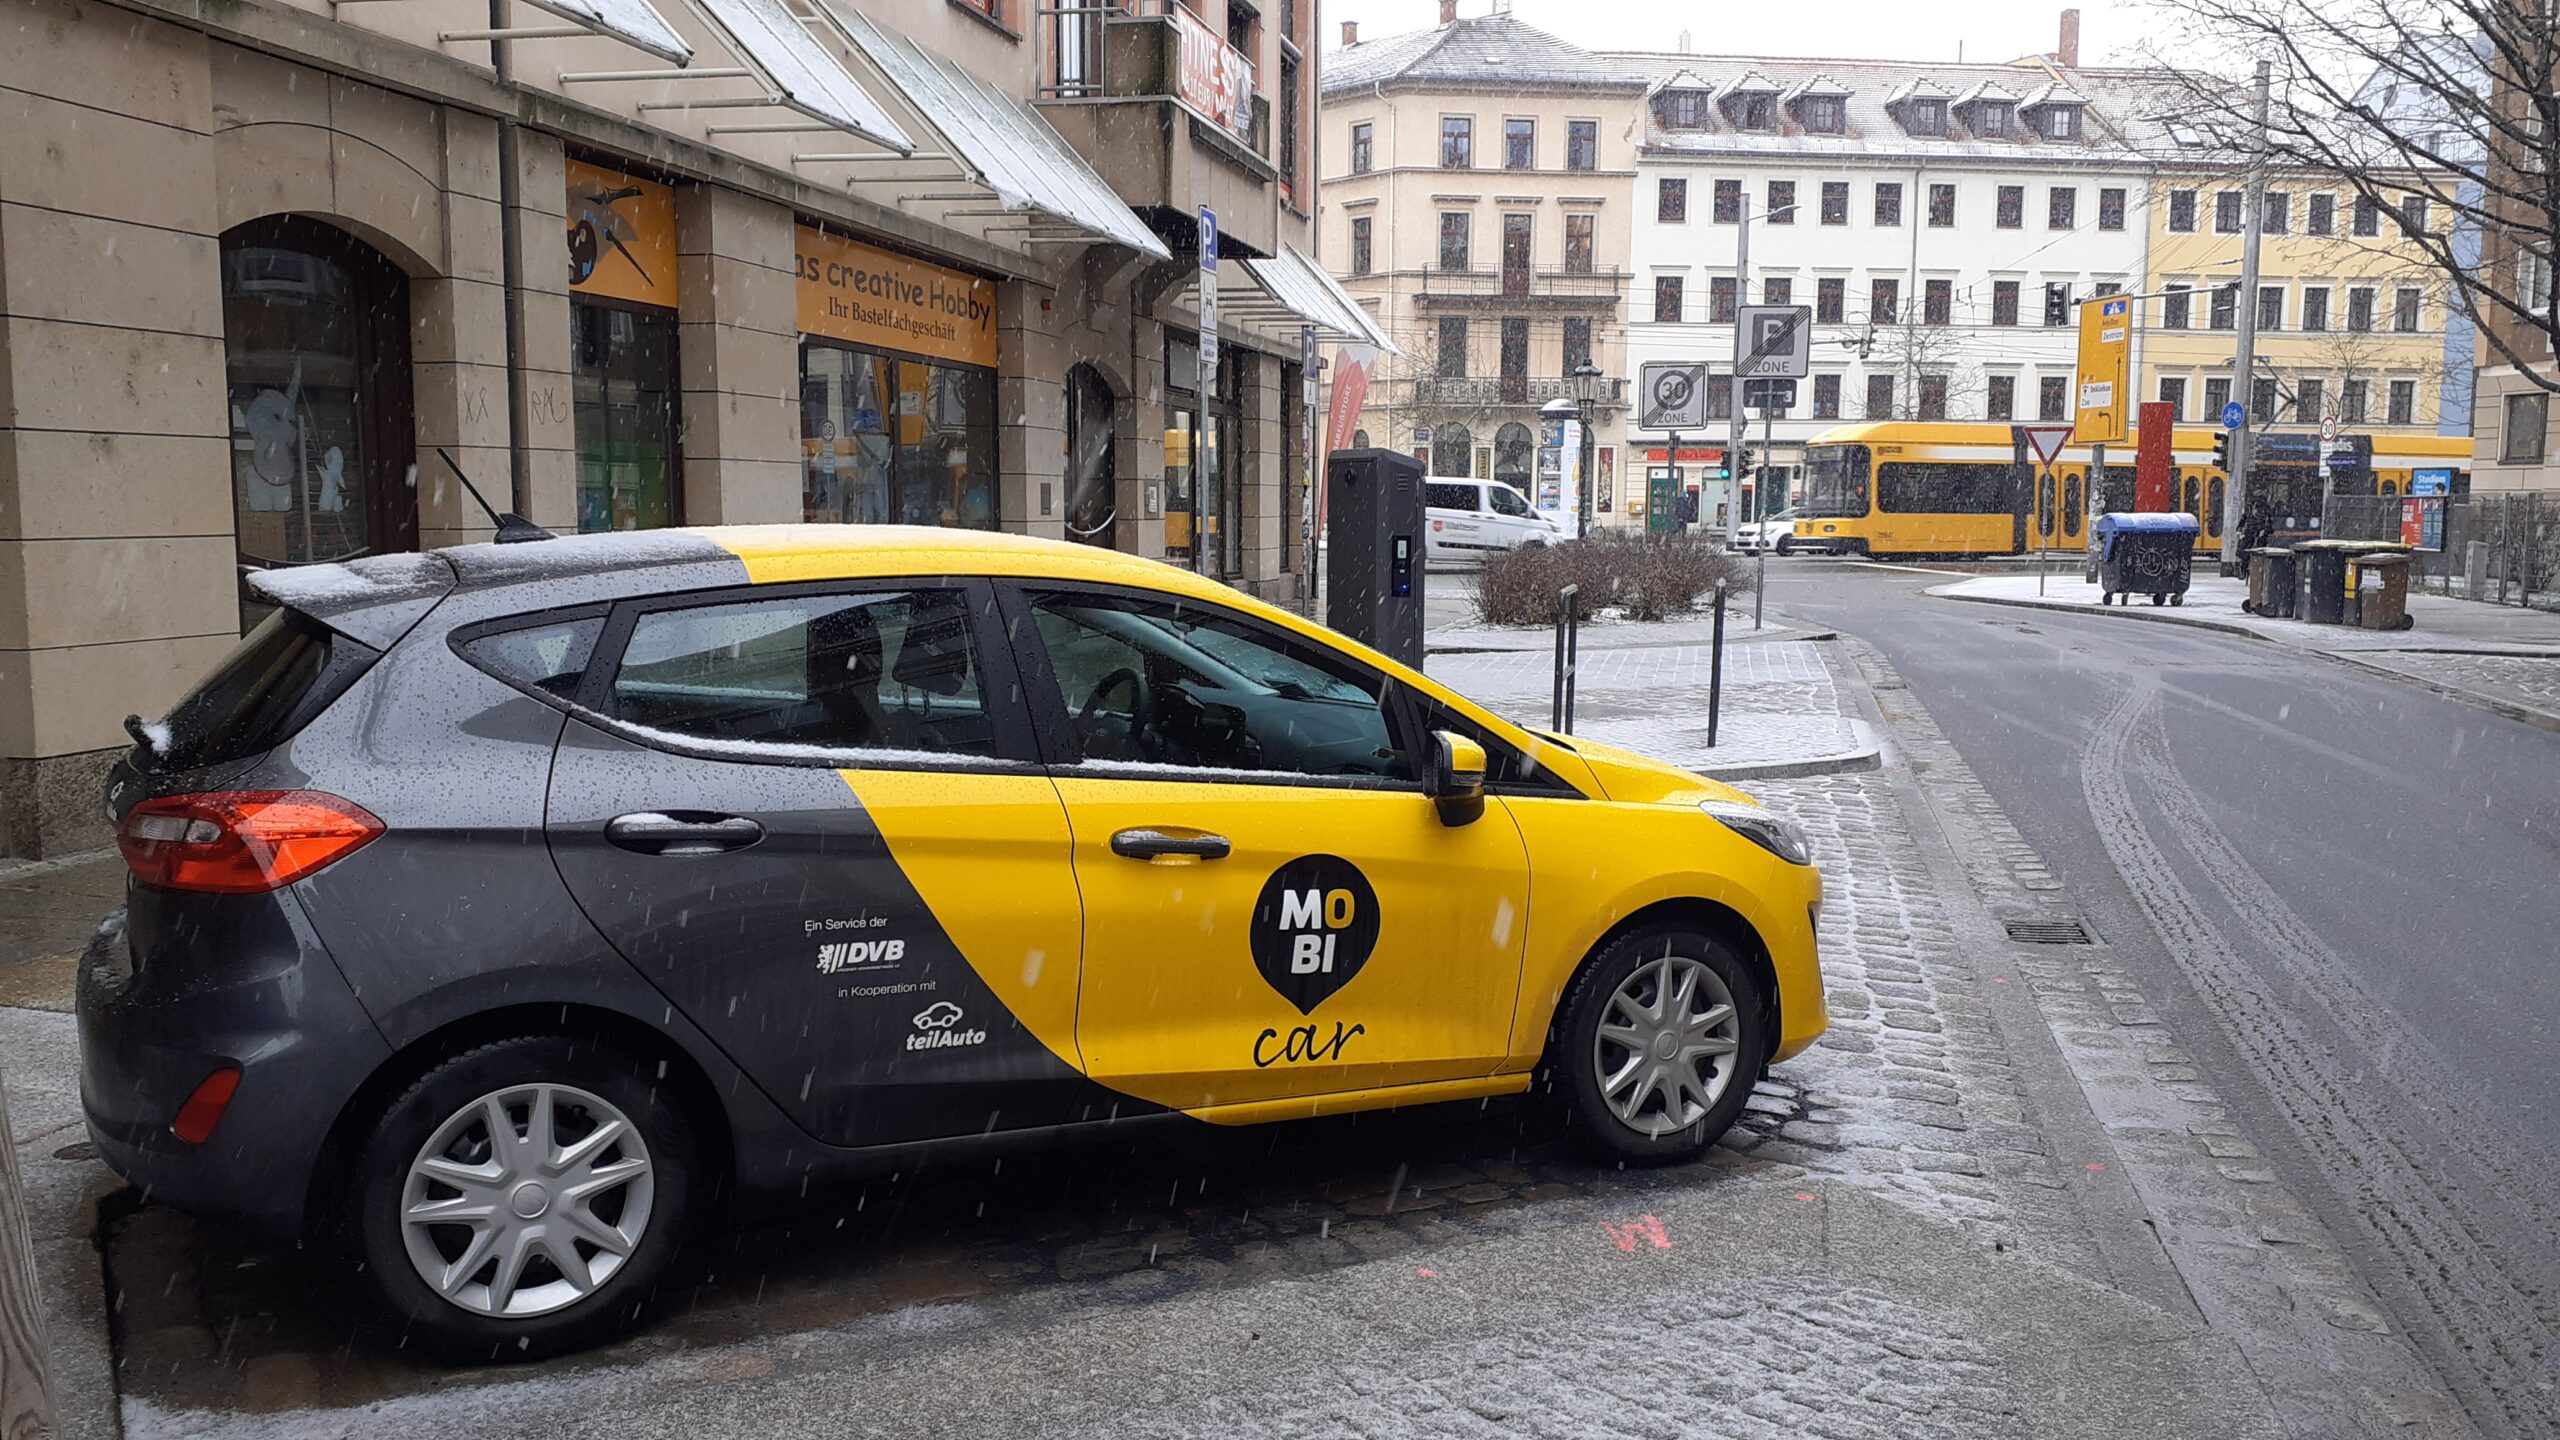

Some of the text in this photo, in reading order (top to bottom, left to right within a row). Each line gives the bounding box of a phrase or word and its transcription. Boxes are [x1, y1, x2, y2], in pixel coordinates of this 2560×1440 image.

[1203, 216, 1213, 261] P
[826, 262, 924, 307] creative
[929, 280, 991, 332] Hobby
[828, 296, 956, 341] Ihr Bastelfachgeschäft
[1307, 335, 1314, 371] P
[1754, 361, 1790, 373] ZONE
[1662, 381, 1687, 401] 30
[1657, 412, 1688, 424] ZONE
[2323, 423, 2333, 435] 30
[1279, 888, 1355, 930] MO
[805, 917, 888, 931] Ein Service der
[847, 940, 905, 964] DVB
[1291, 934, 1336, 974] BI
[838, 980, 936, 998] in Kooperation mit
[906, 1028, 986, 1050] teilAuto
[1254, 1021, 1365, 1068] car
